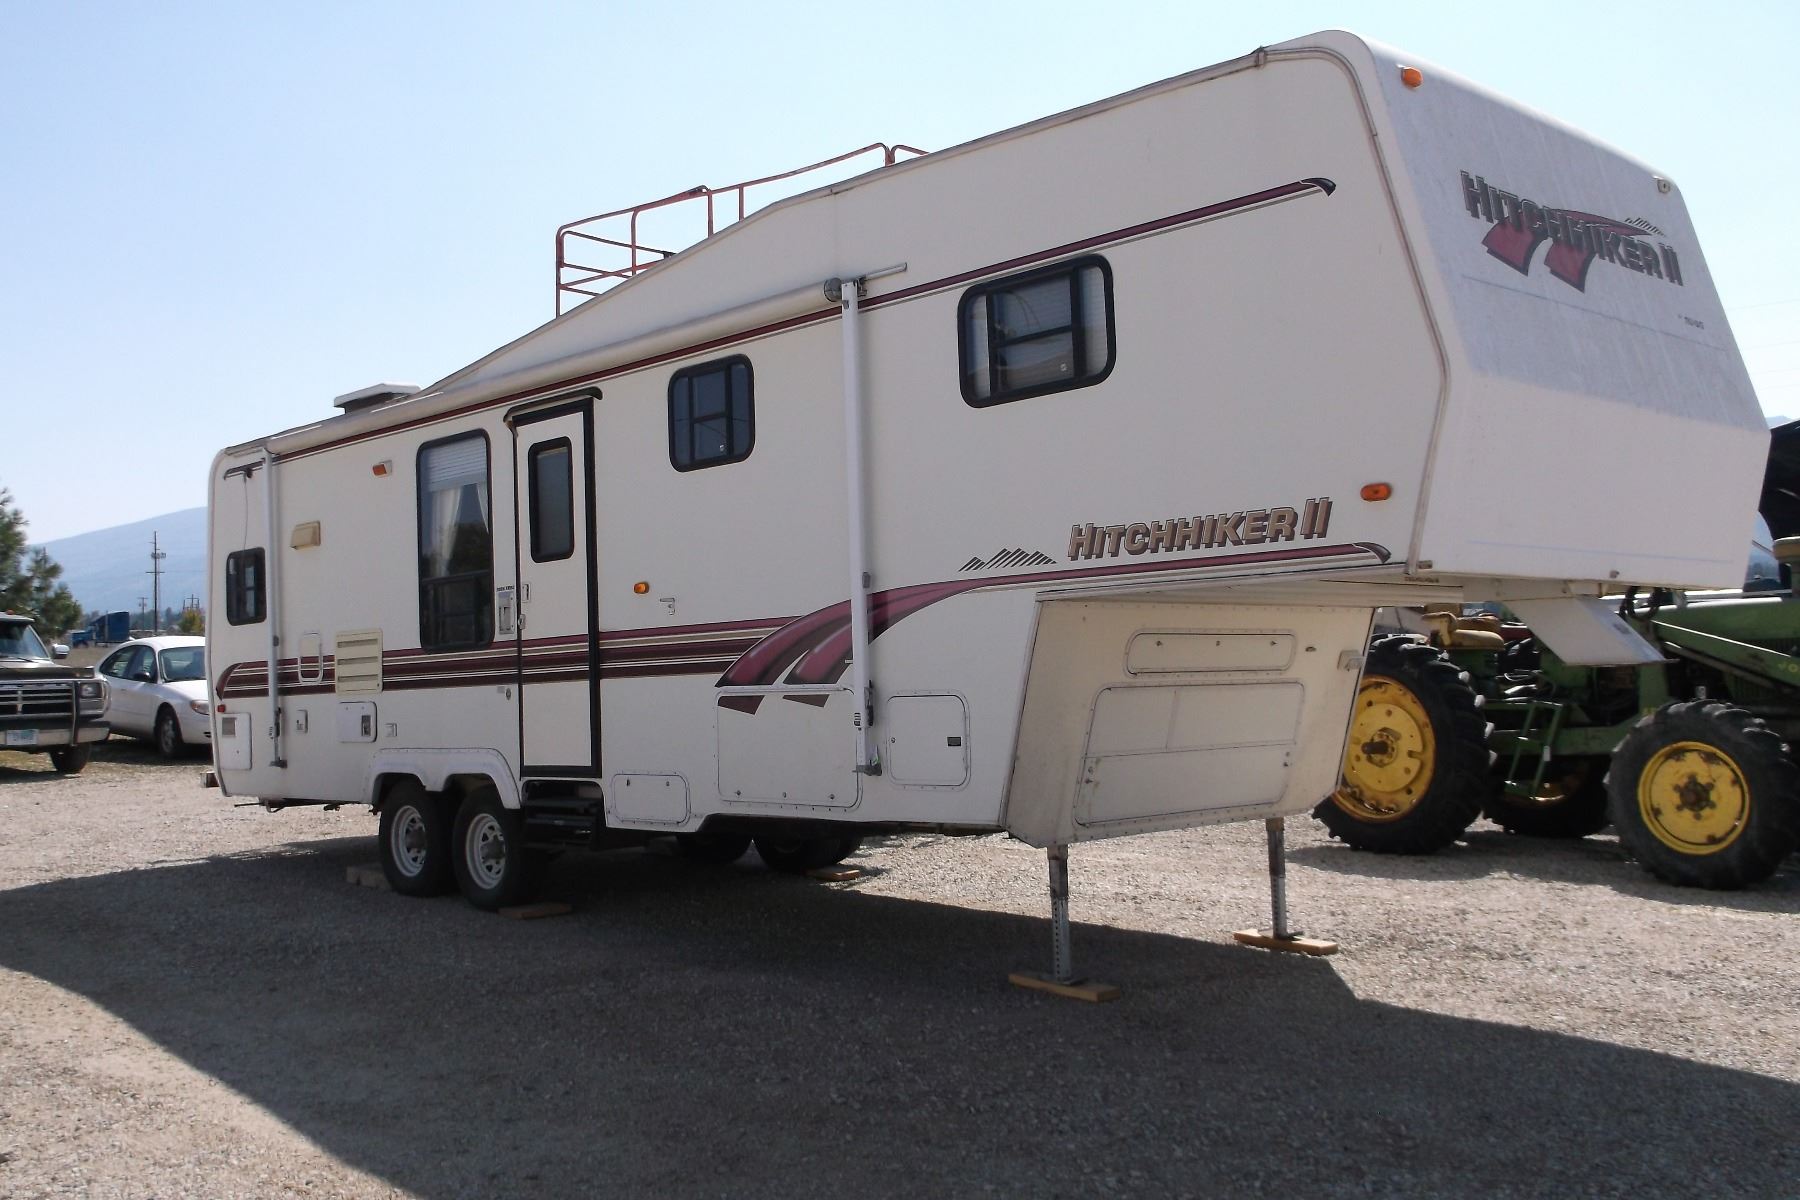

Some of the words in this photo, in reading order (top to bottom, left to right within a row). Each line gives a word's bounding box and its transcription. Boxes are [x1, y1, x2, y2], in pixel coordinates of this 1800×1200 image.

[1460, 170, 1664, 280] HITCHHIKER
[1067, 506, 1299, 561] HITCHHIKER
[1301, 497, 1333, 540] II
